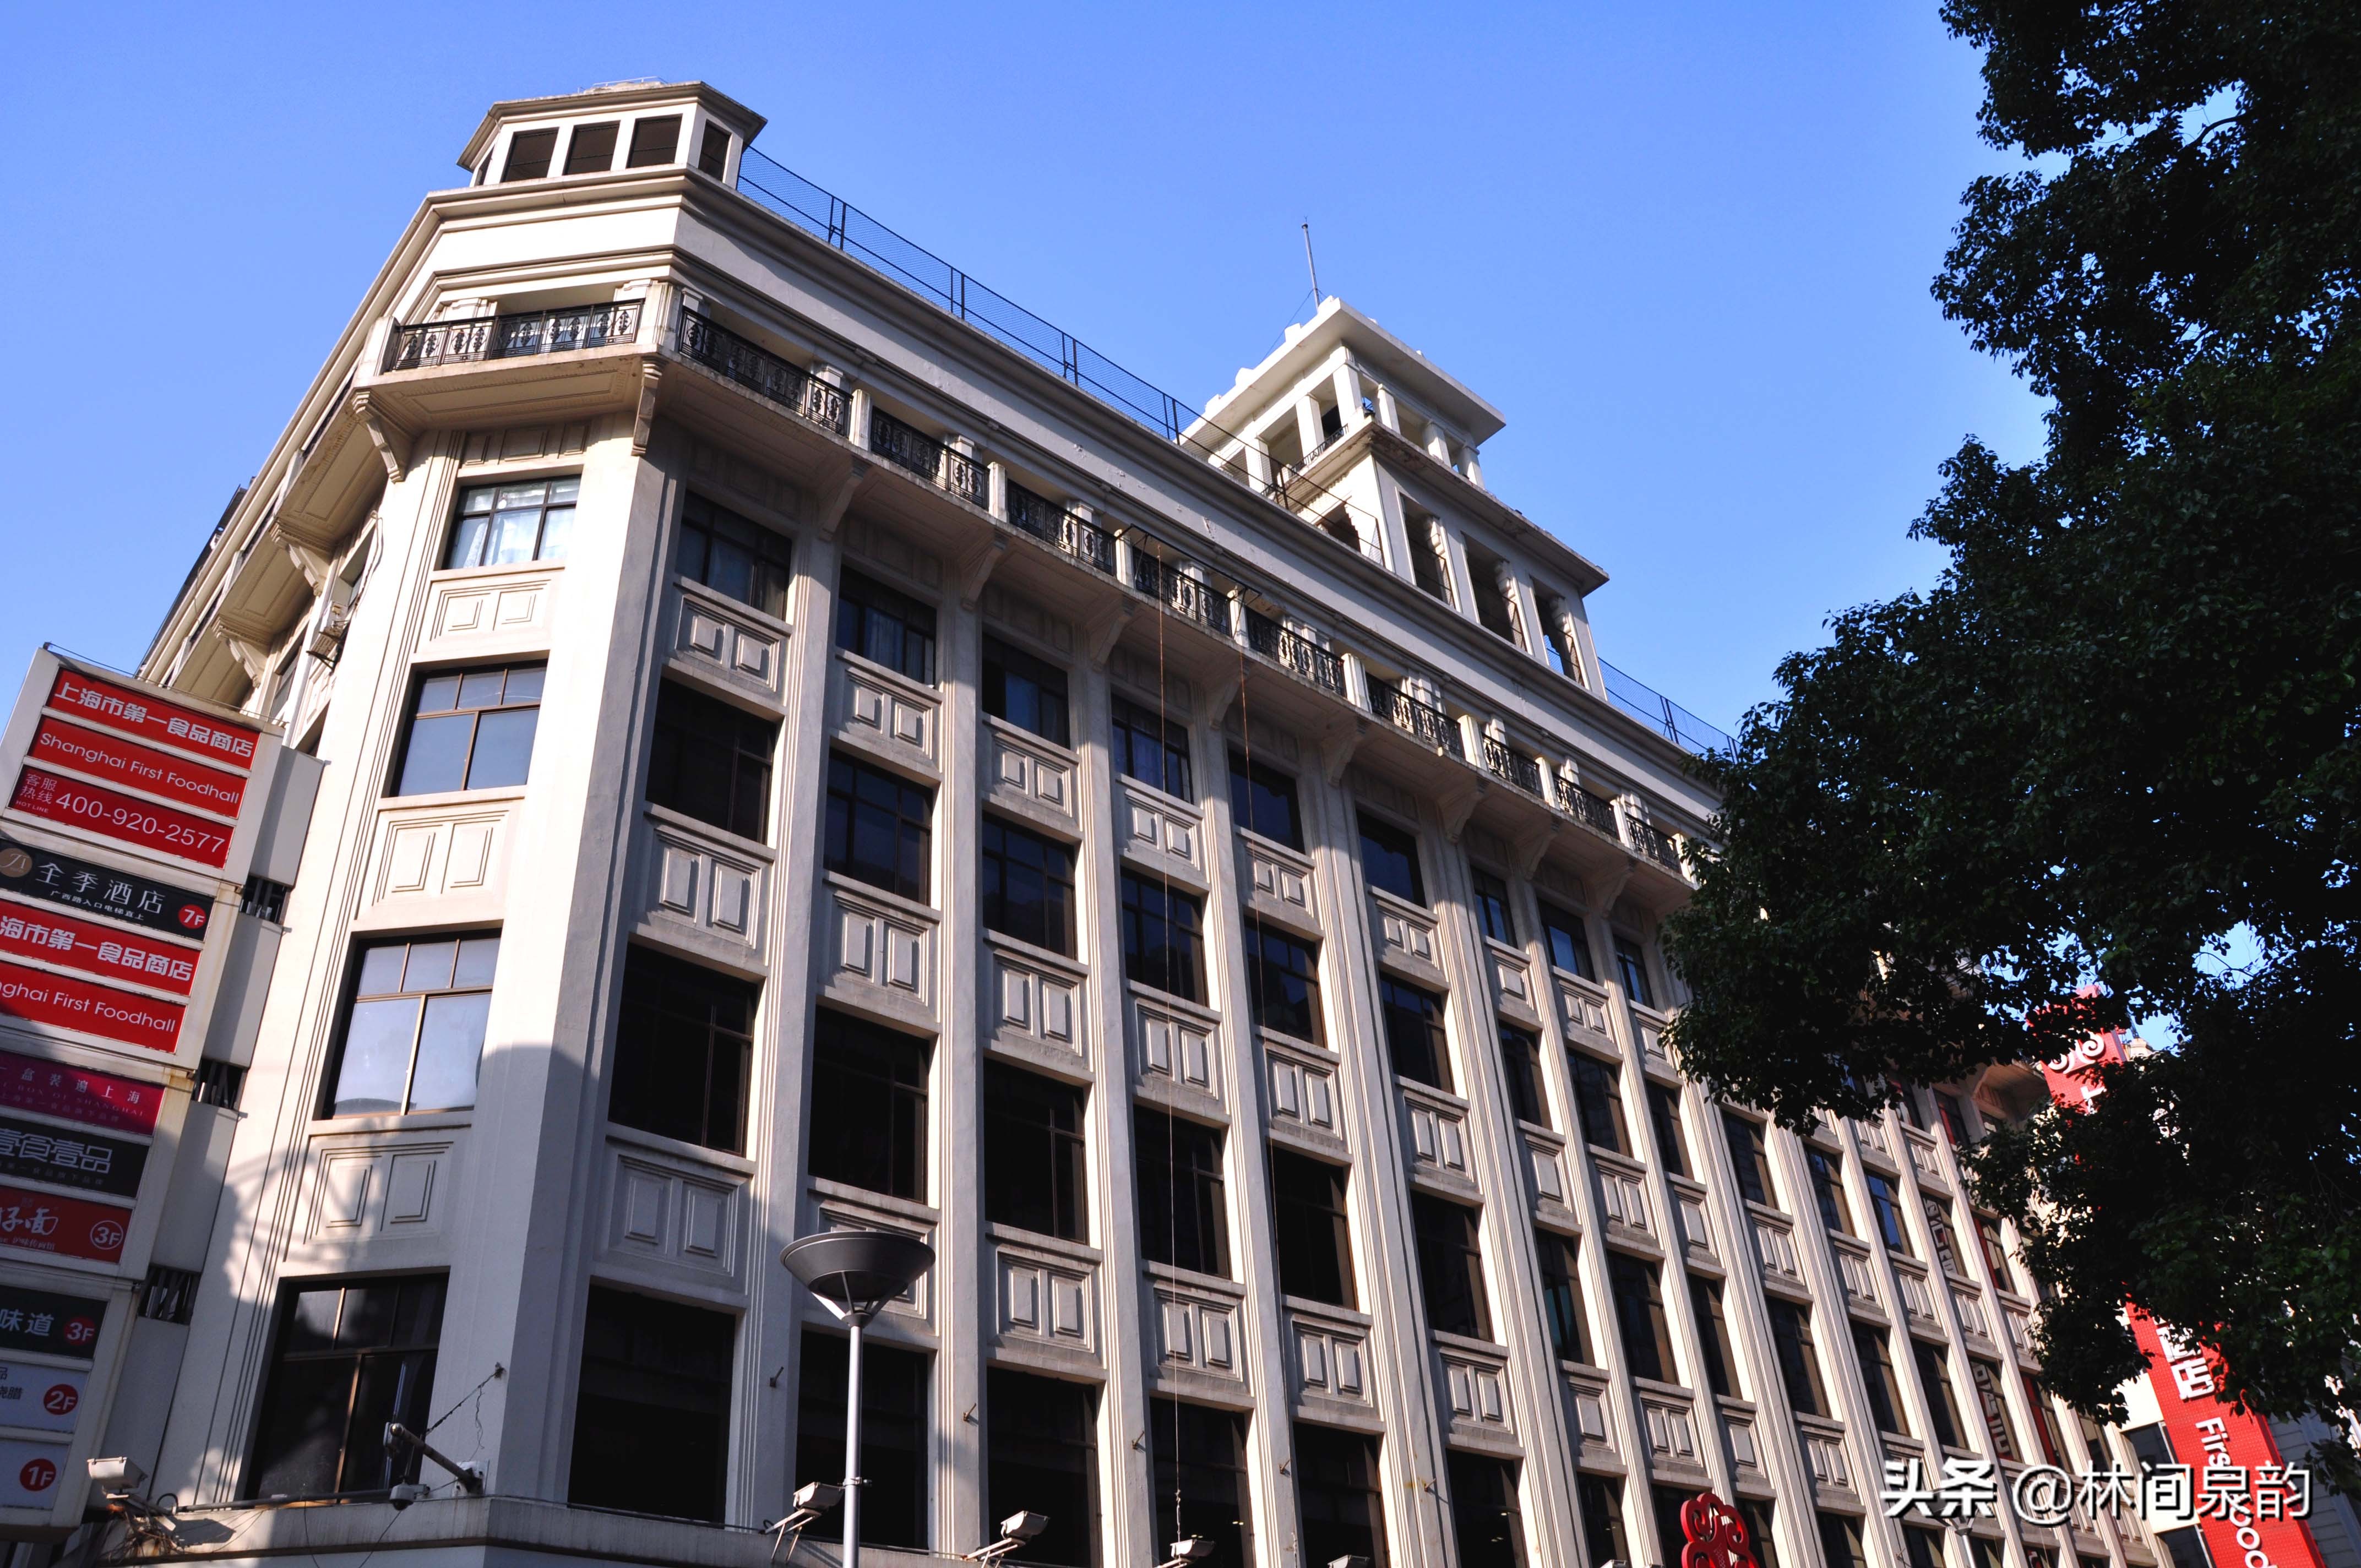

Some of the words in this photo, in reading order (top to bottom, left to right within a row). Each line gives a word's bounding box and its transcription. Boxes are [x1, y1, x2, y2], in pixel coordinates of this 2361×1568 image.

[55, 682, 254, 758] 上海市第一食品商店
[40, 732, 126, 769] Shanghai
[130, 760, 164, 781] First
[166, 772, 240, 804] Foodhall
[20, 785, 54, 805] 热线
[25, 774, 57, 792] 客服
[56, 793, 225, 853] 400-920-2577
[35, 862, 166, 914] 全季酒店
[50, 890, 144, 922] 广西路入口电梯直上
[183, 908, 204, 925] 7F
[53, 992, 90, 1012] First
[94, 1002, 176, 1033] Foodhall
[95, 1227, 121, 1245] 3F
[67, 1322, 95, 1342] 3F
[47, 1391, 76, 1410] 2F
[2195, 1417, 2237, 1481] Firs
[28, 1466, 53, 1485] 1F
